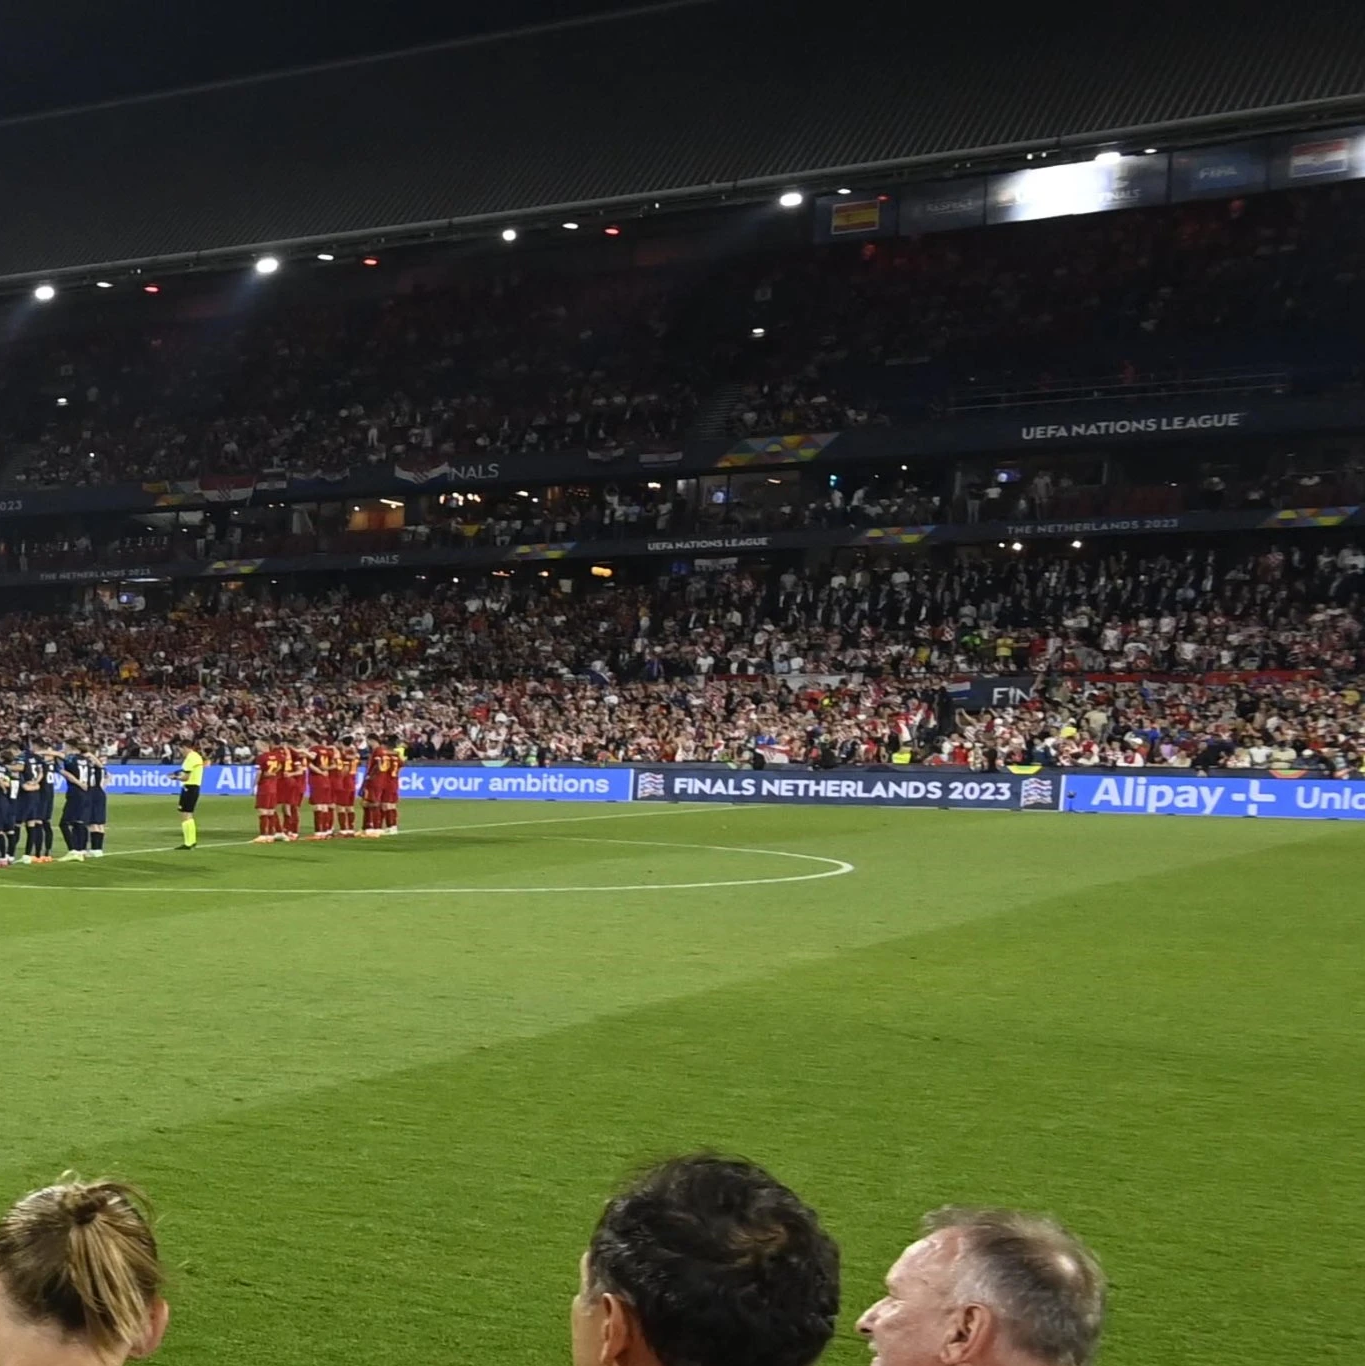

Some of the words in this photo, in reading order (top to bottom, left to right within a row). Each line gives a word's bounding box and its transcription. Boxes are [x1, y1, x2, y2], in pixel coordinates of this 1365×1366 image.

[1022, 424, 1069, 441] UEFA
[1071, 418, 1158, 437] NATIONS
[1161, 413, 1240, 431] LEAGUE
[1007, 525, 1034, 536] THE
[1036, 520, 1139, 534] NETHERLANDS
[1144, 518, 1180, 530] 2023
[647, 542, 674, 551] UEFA
[675, 540, 724, 550] NATIONS
[725, 537, 769, 548] LEAGUE
[430, 774, 483, 796] your
[488, 772, 610, 794] ambitions
[674, 778, 756, 796] FINALS
[761, 779, 943, 799] NETHERLANDS
[948, 781, 1012, 801] 2023
